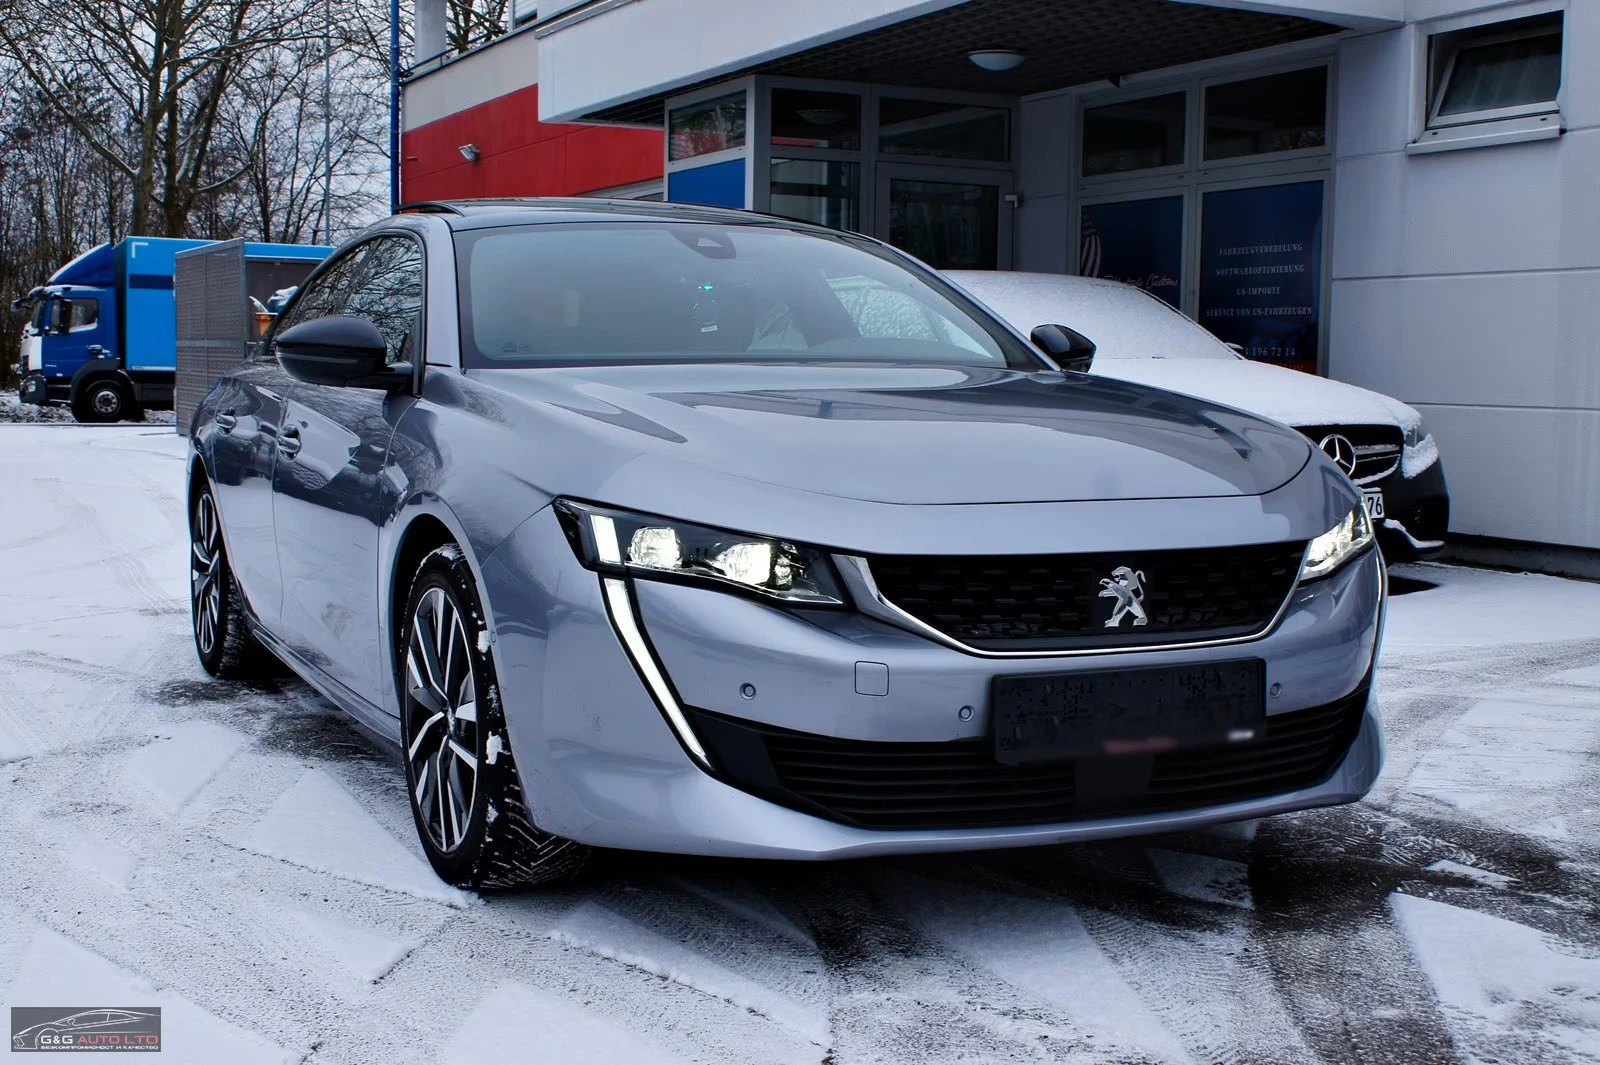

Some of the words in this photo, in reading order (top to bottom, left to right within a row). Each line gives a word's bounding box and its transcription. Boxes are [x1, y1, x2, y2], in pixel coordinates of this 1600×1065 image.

[1219, 243, 1303, 256] FAHRZEUGVEREDELUNG
[1215, 264, 1304, 276] SOFTWAREOPTIMIERUNG
[1236, 286, 1280, 296] US-IMPORTE
[1206, 308, 1235, 317] SERVICE
[1236, 308, 1250, 316] VON
[1252, 307, 1312, 316] US-FAHRZEUGEN
[1253, 347, 1268, 357] 196
[1271, 347, 1282, 357] 72
[1285, 347, 1295, 357] 14
[1367, 496, 1383, 516] 76
